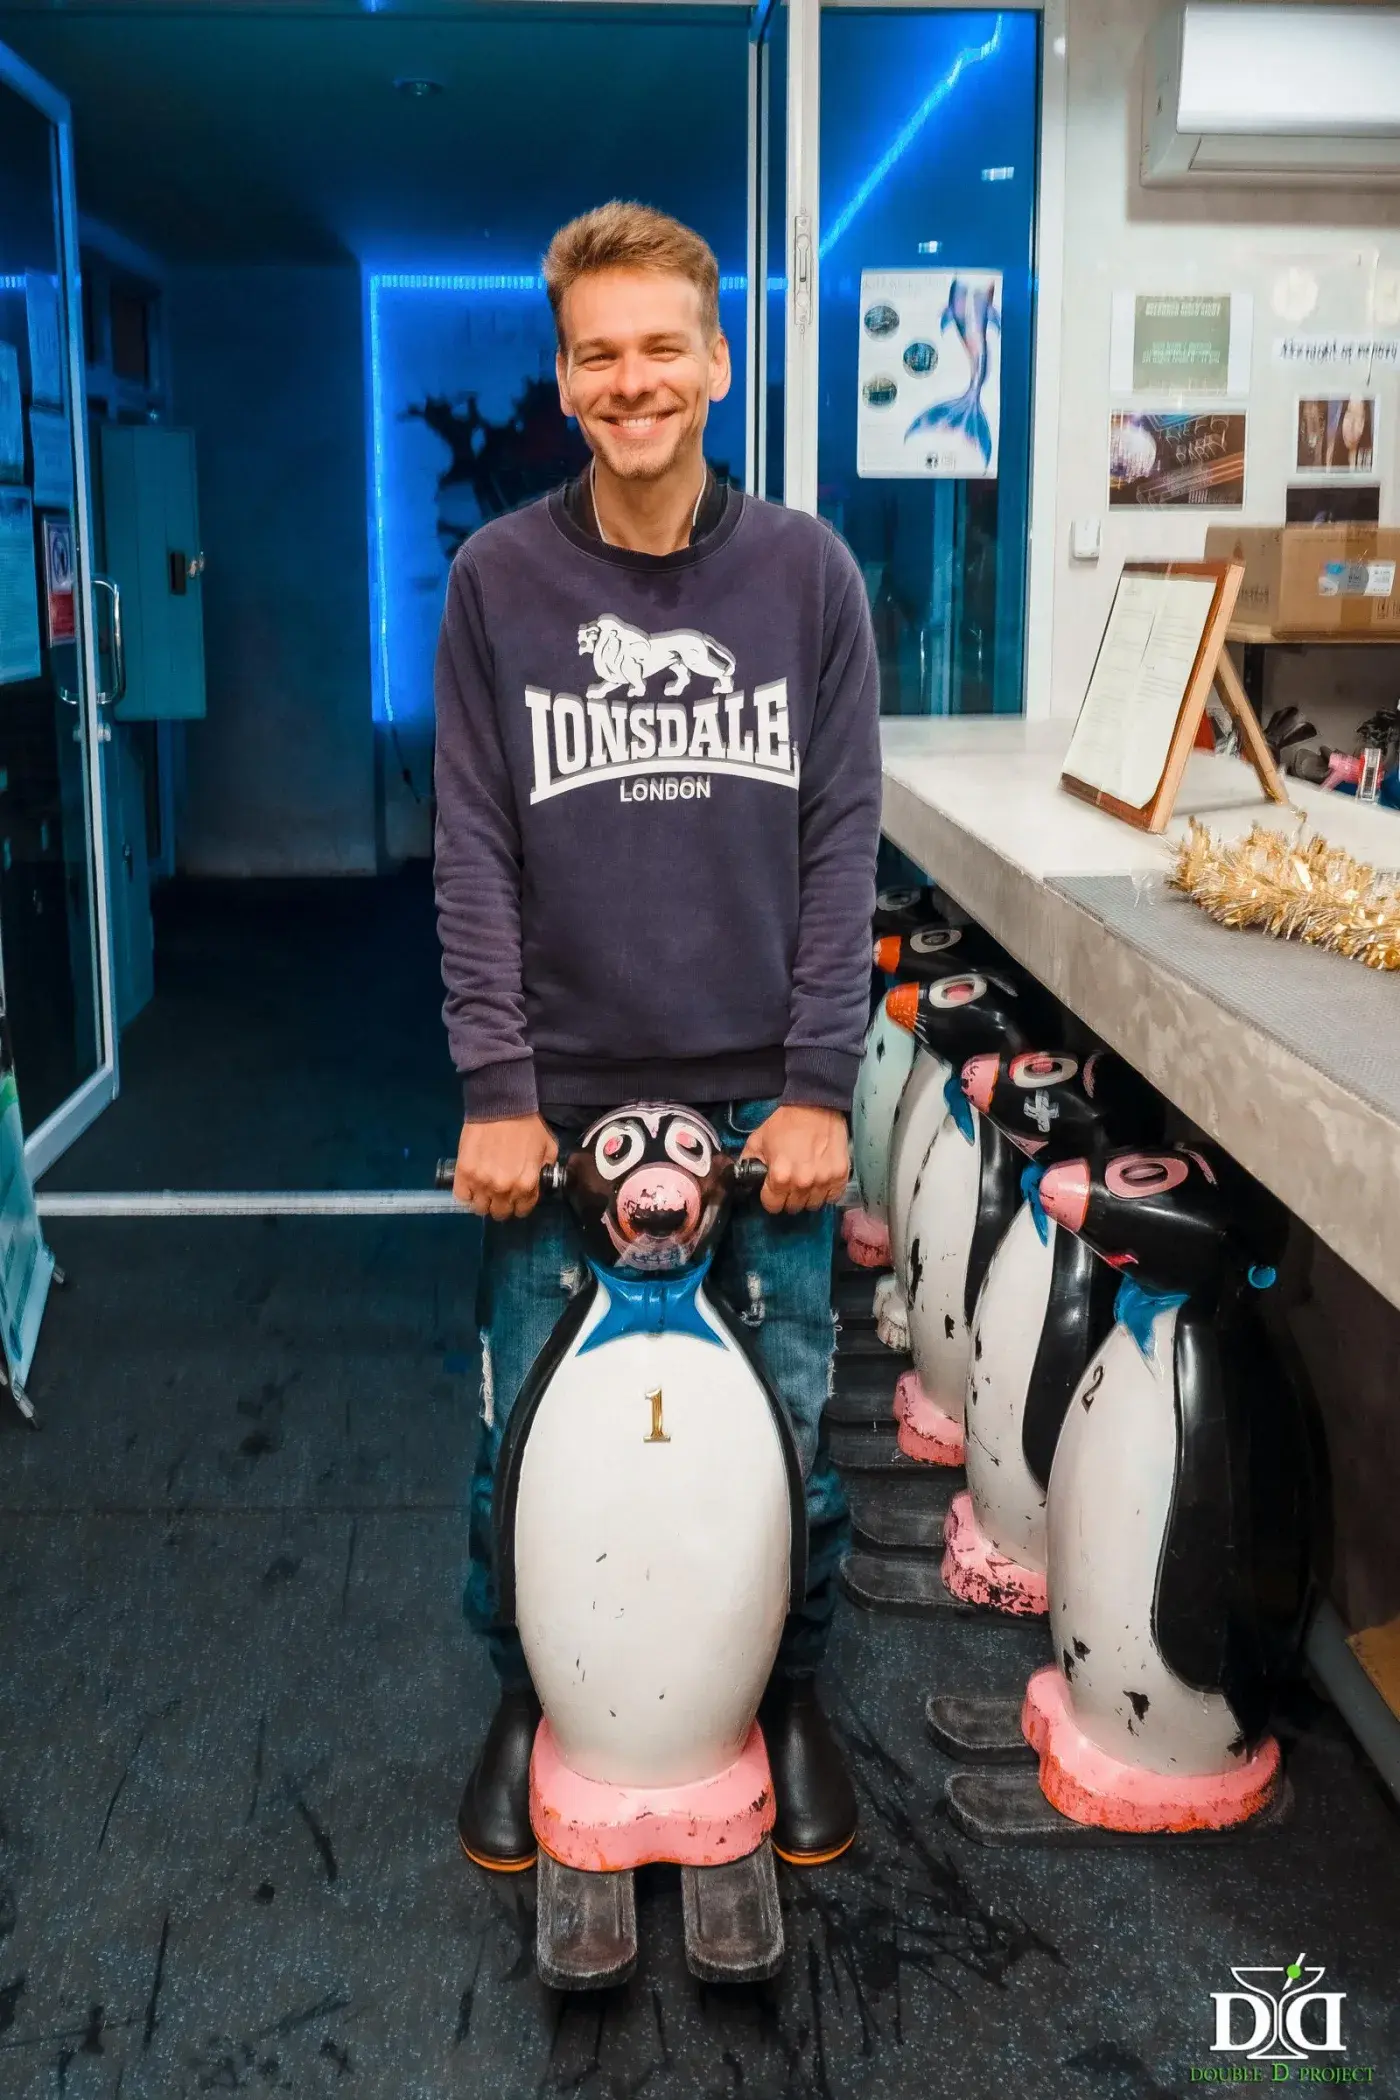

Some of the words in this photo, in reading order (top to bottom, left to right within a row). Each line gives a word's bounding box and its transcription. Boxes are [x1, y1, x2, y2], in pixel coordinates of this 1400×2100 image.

[525, 677, 800, 805] LONSDALE
[619, 776, 711, 803] LONDON
[643, 1387, 671, 1443] 1
